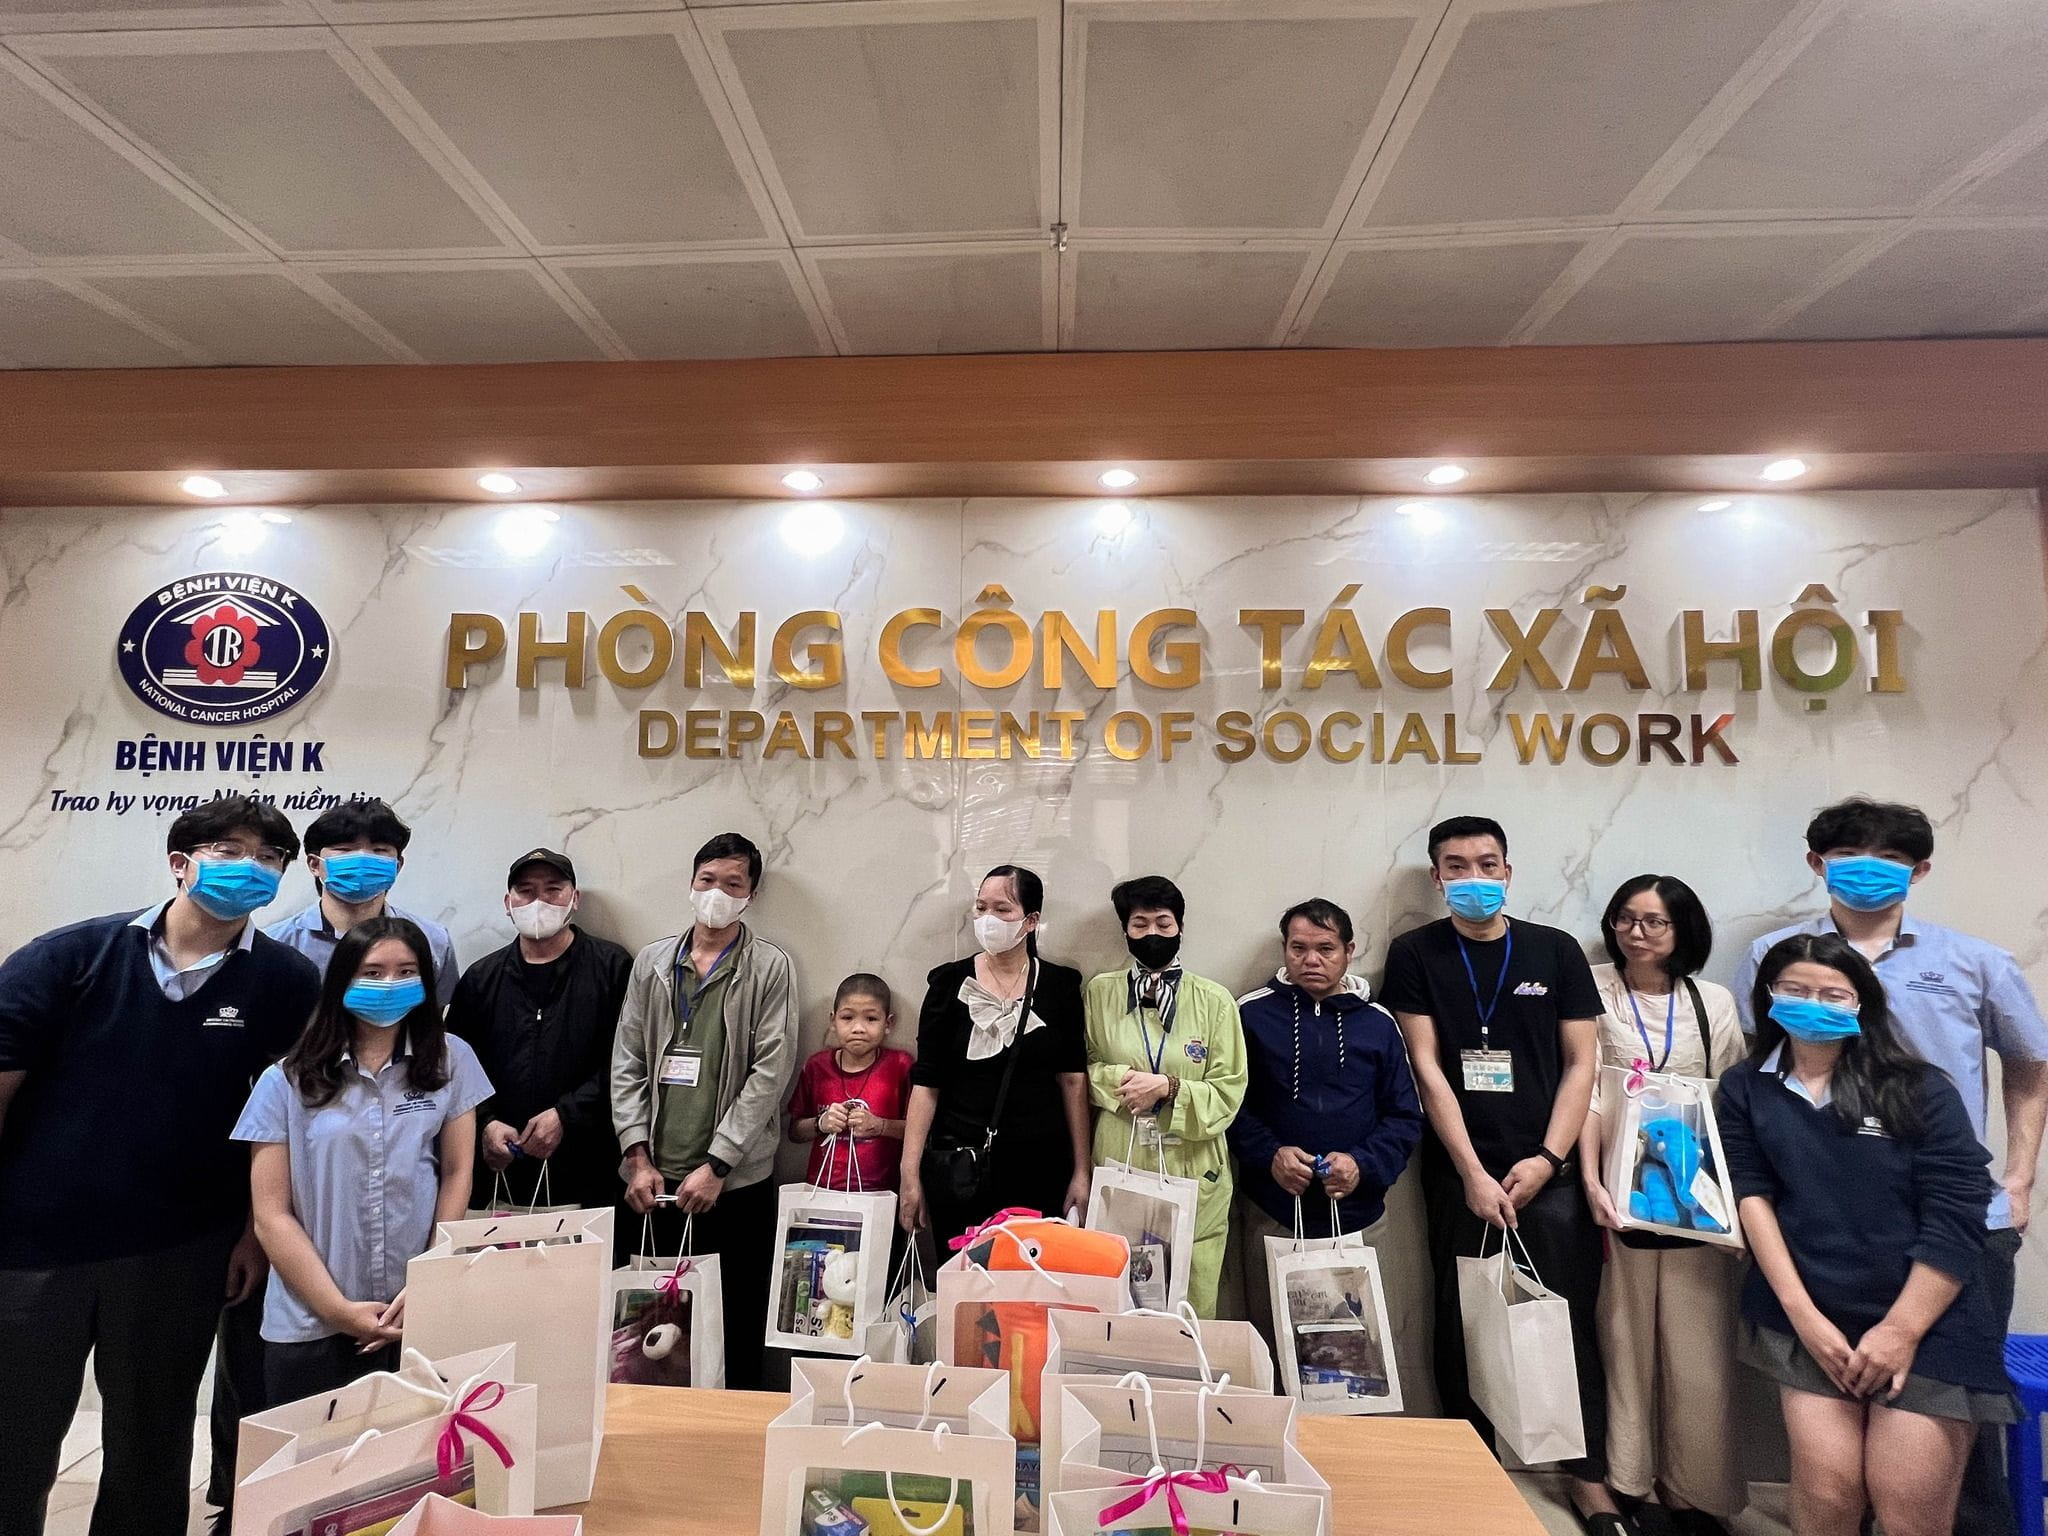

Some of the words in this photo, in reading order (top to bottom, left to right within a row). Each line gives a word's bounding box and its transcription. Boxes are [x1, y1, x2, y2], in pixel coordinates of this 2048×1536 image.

[157, 576, 221, 606] BỆNH
[224, 576, 278, 599] VIỆN
[280, 590, 299, 610] K
[445, 584, 844, 690] PHÒNG
[877, 583, 1201, 690] CÔNG
[1238, 583, 1454, 691] TÁC
[1484, 584, 1653, 692] XÃ
[1680, 583, 1904, 711] HỘI
[139, 677, 188, 718] NATIONAL
[190, 708, 241, 722] CANCER
[243, 686, 300, 718] HOSPITAL
[115, 734, 207, 778] BỆNH
[215, 734, 293, 779] VIỆN
[301, 741, 326, 773] K
[638, 709, 1085, 761] DEPARTMENT
[1104, 710, 1193, 763] OF
[1215, 710, 1483, 765] SOCIAL
[1505, 712, 1740, 767] WORK
[50, 788, 100, 812] Trao
[105, 791, 136, 815] hy
[282, 785, 342, 810] niềm
